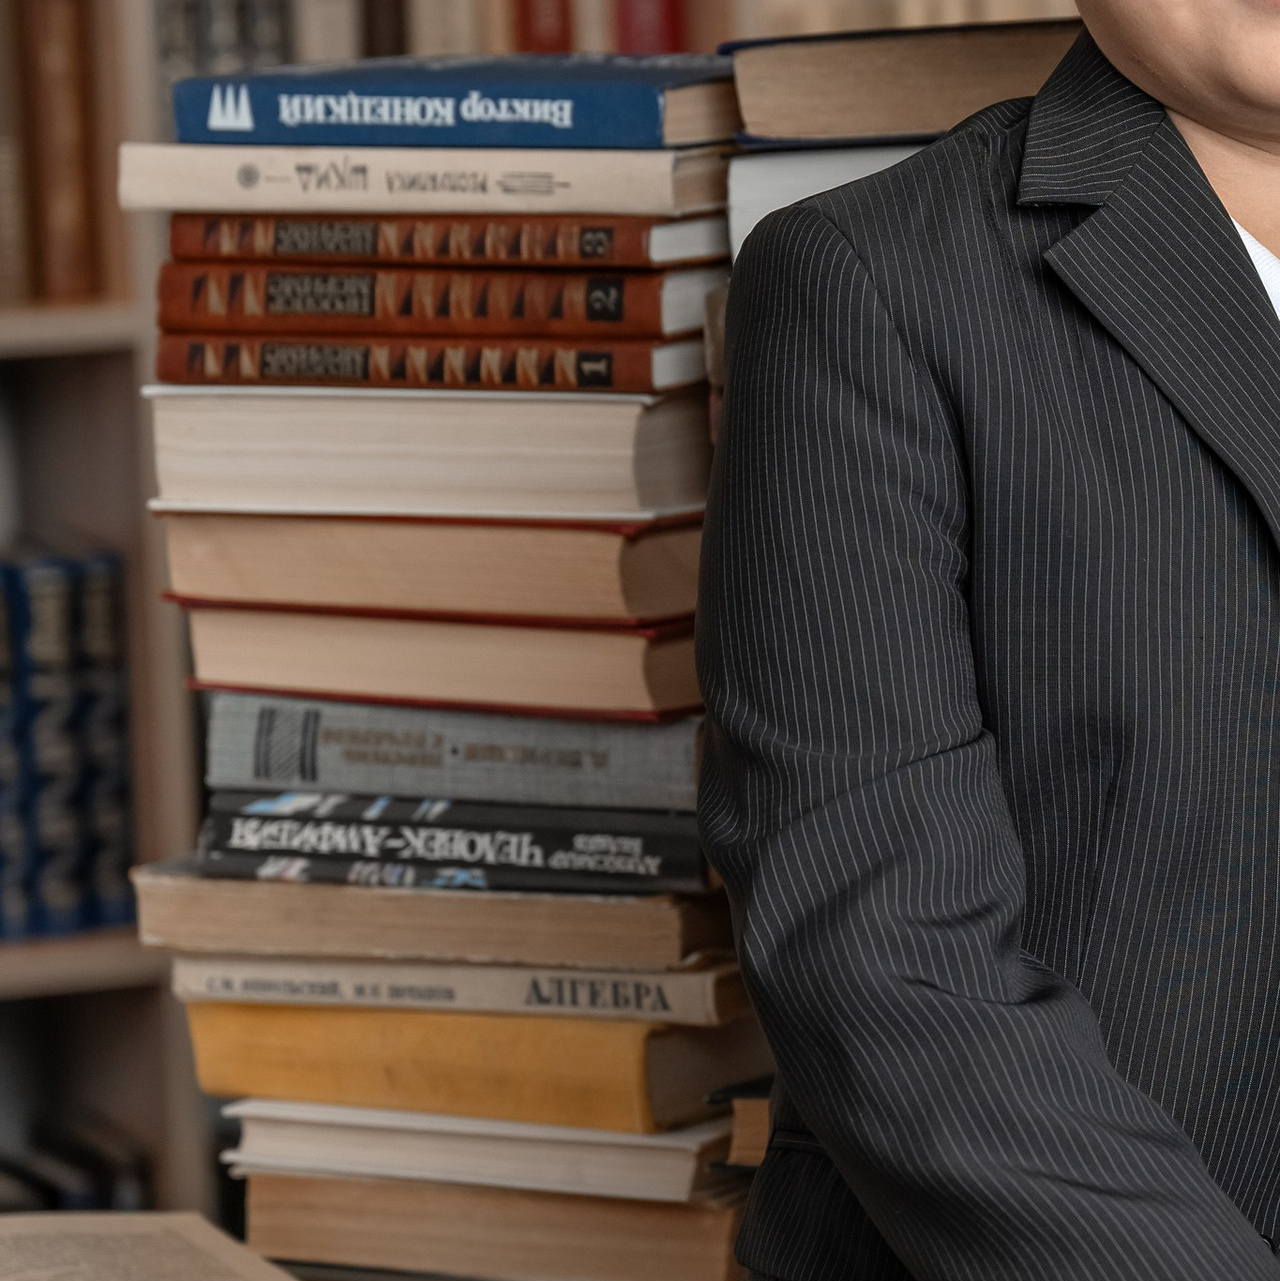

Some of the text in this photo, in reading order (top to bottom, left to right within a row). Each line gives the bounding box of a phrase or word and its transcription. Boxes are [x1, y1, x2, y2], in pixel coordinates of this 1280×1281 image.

[277, 89, 573, 128] Виктор КОНЕЦКИЙ
[589, 287, 618, 313] 2
[580, 358, 608, 378] 1
[227, 817, 544, 869] ЧЕЛОВЕК-АМФИБИЯ
[524, 977, 672, 1014] АЛГЕБРА
